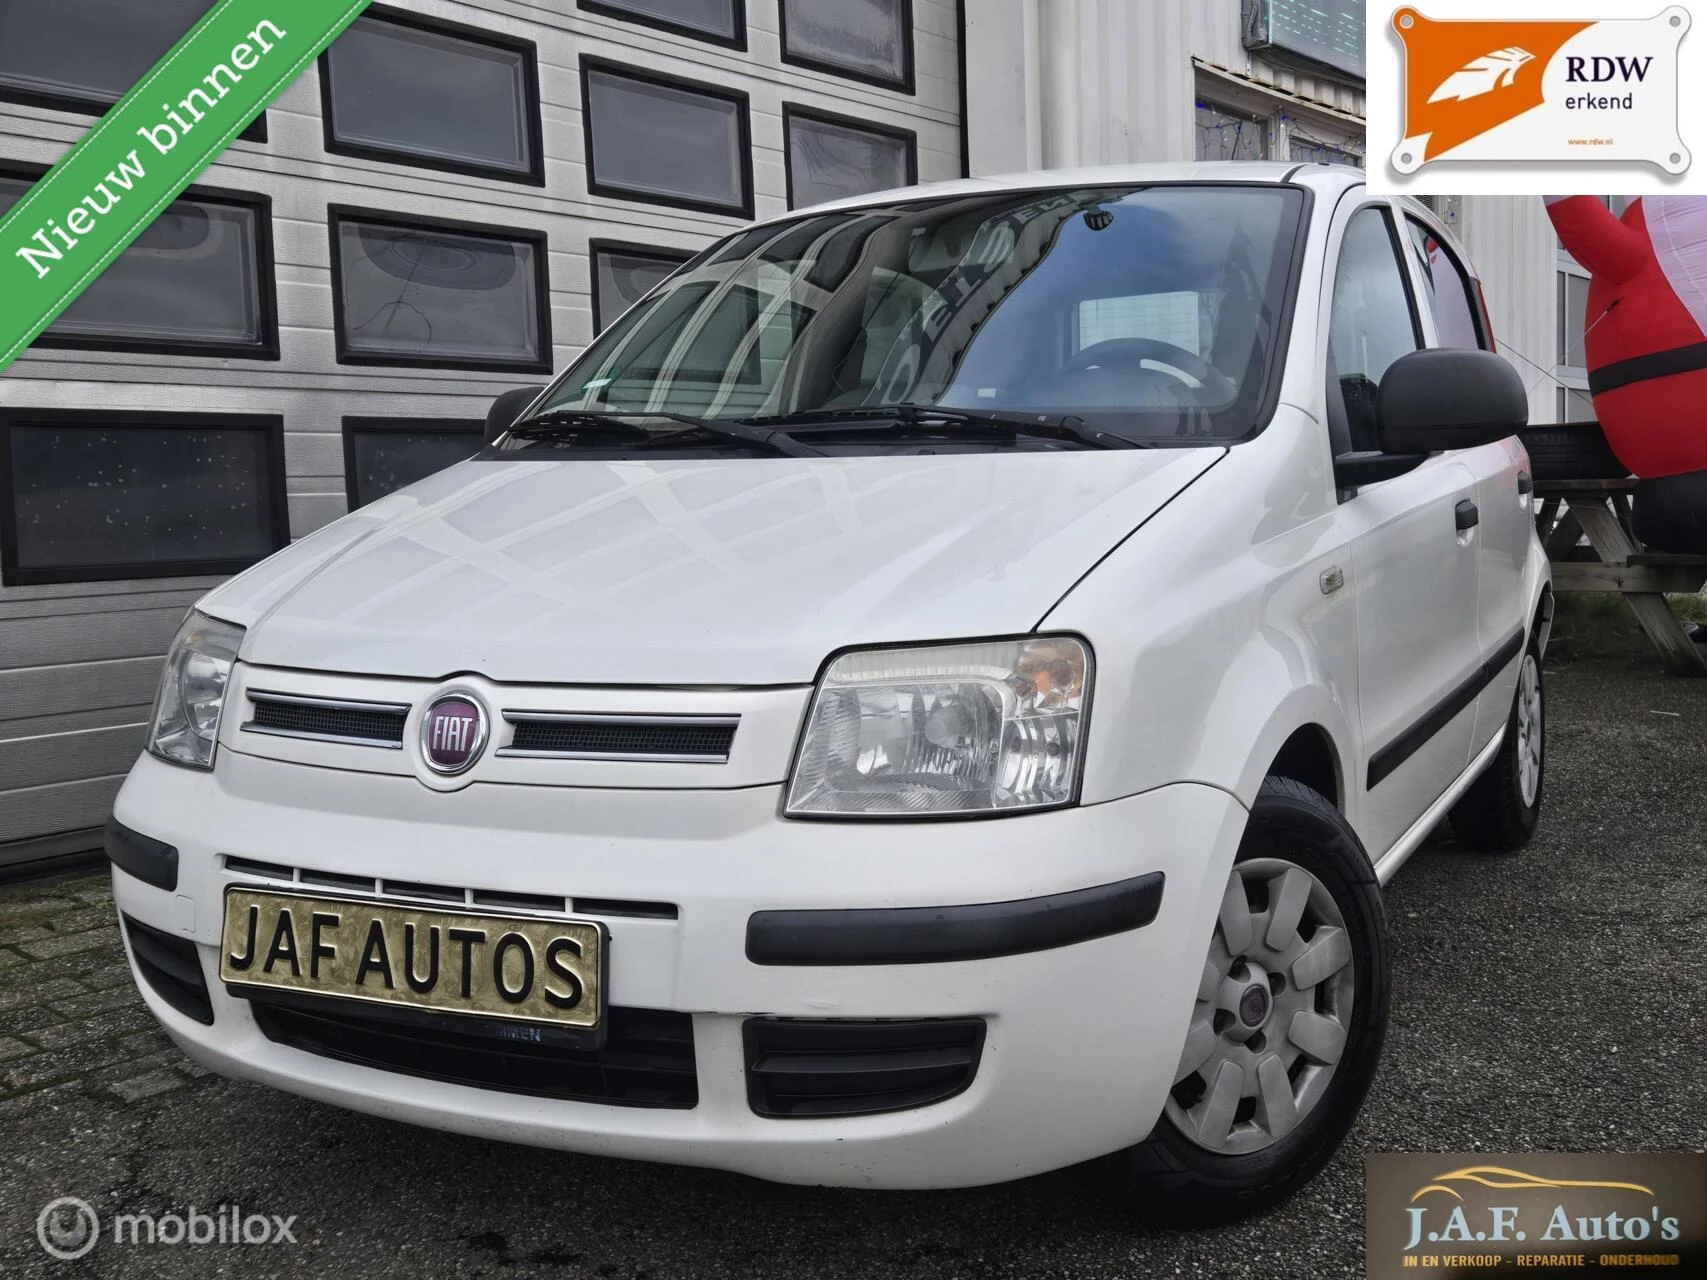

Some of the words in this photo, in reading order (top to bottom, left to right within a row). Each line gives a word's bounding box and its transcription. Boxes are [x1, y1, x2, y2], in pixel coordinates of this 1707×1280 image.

[432, 715, 473, 752] FIAT
[230, 905, 341, 978] JAF
[355, 919, 584, 1009] AUTOS
